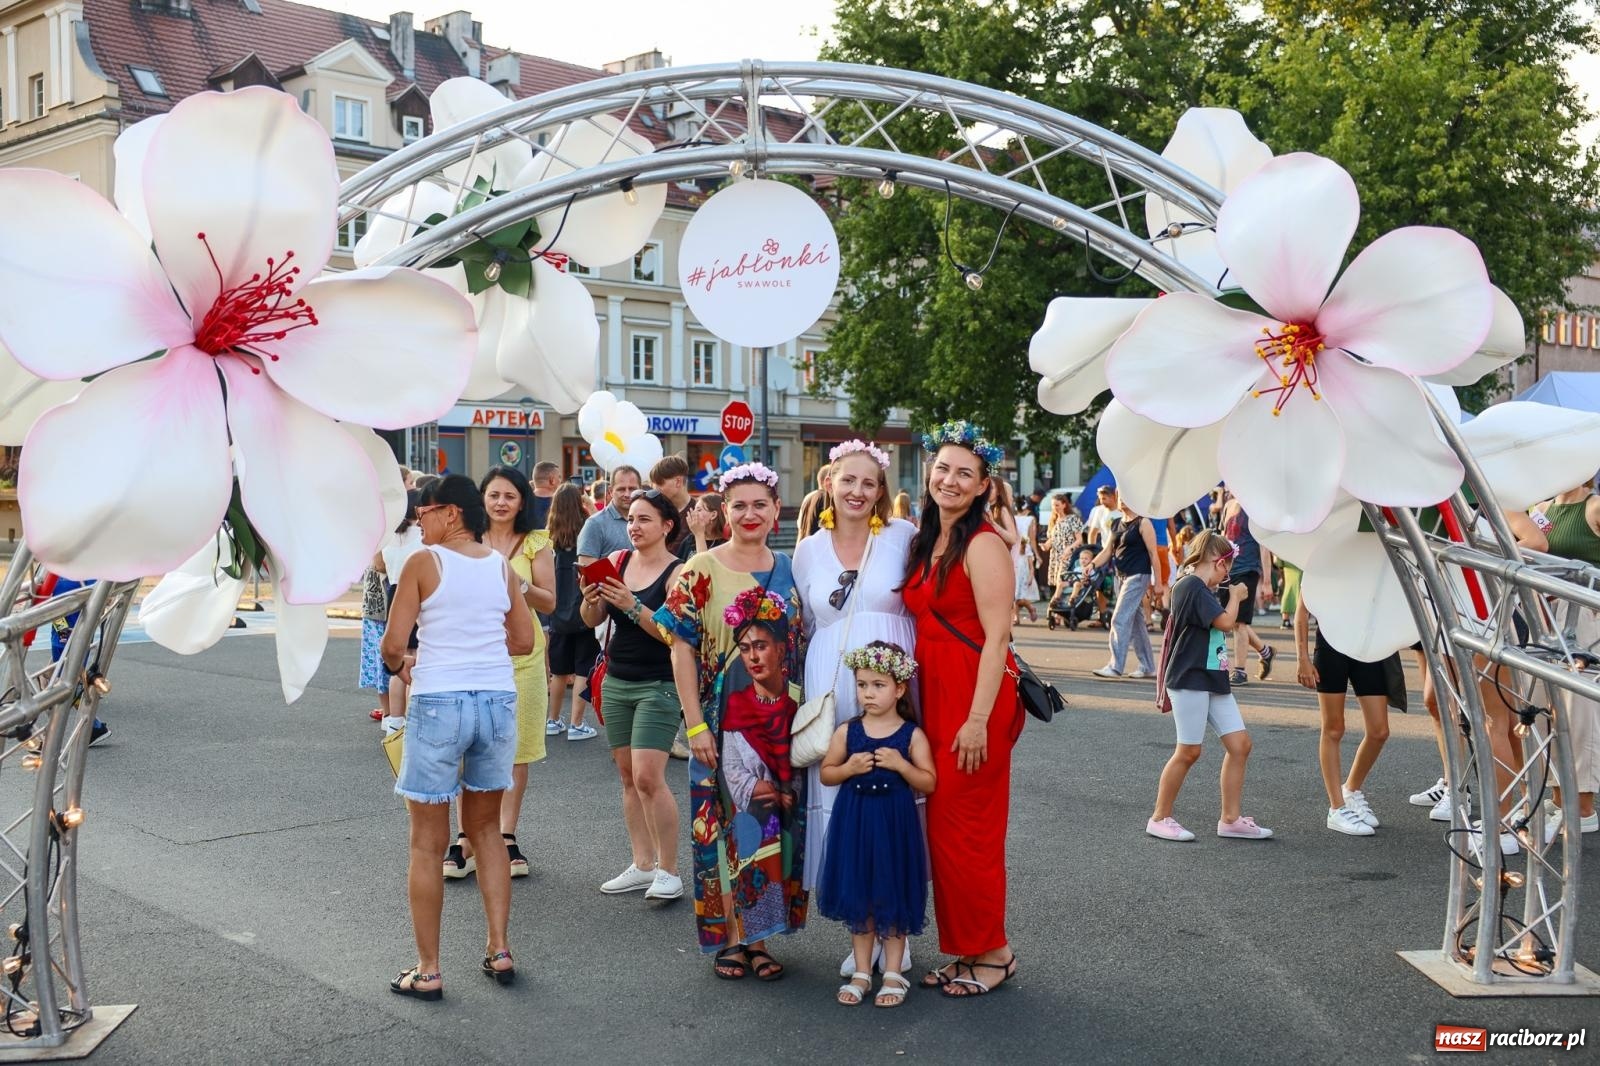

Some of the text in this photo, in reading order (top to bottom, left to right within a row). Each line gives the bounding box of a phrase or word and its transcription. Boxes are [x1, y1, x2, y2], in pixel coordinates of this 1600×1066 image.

[687, 243, 830, 291] #jabłonki
[737, 279, 792, 289] SWAWOLE
[472, 409, 542, 427] APTEKA
[724, 414, 752, 431] STOP
